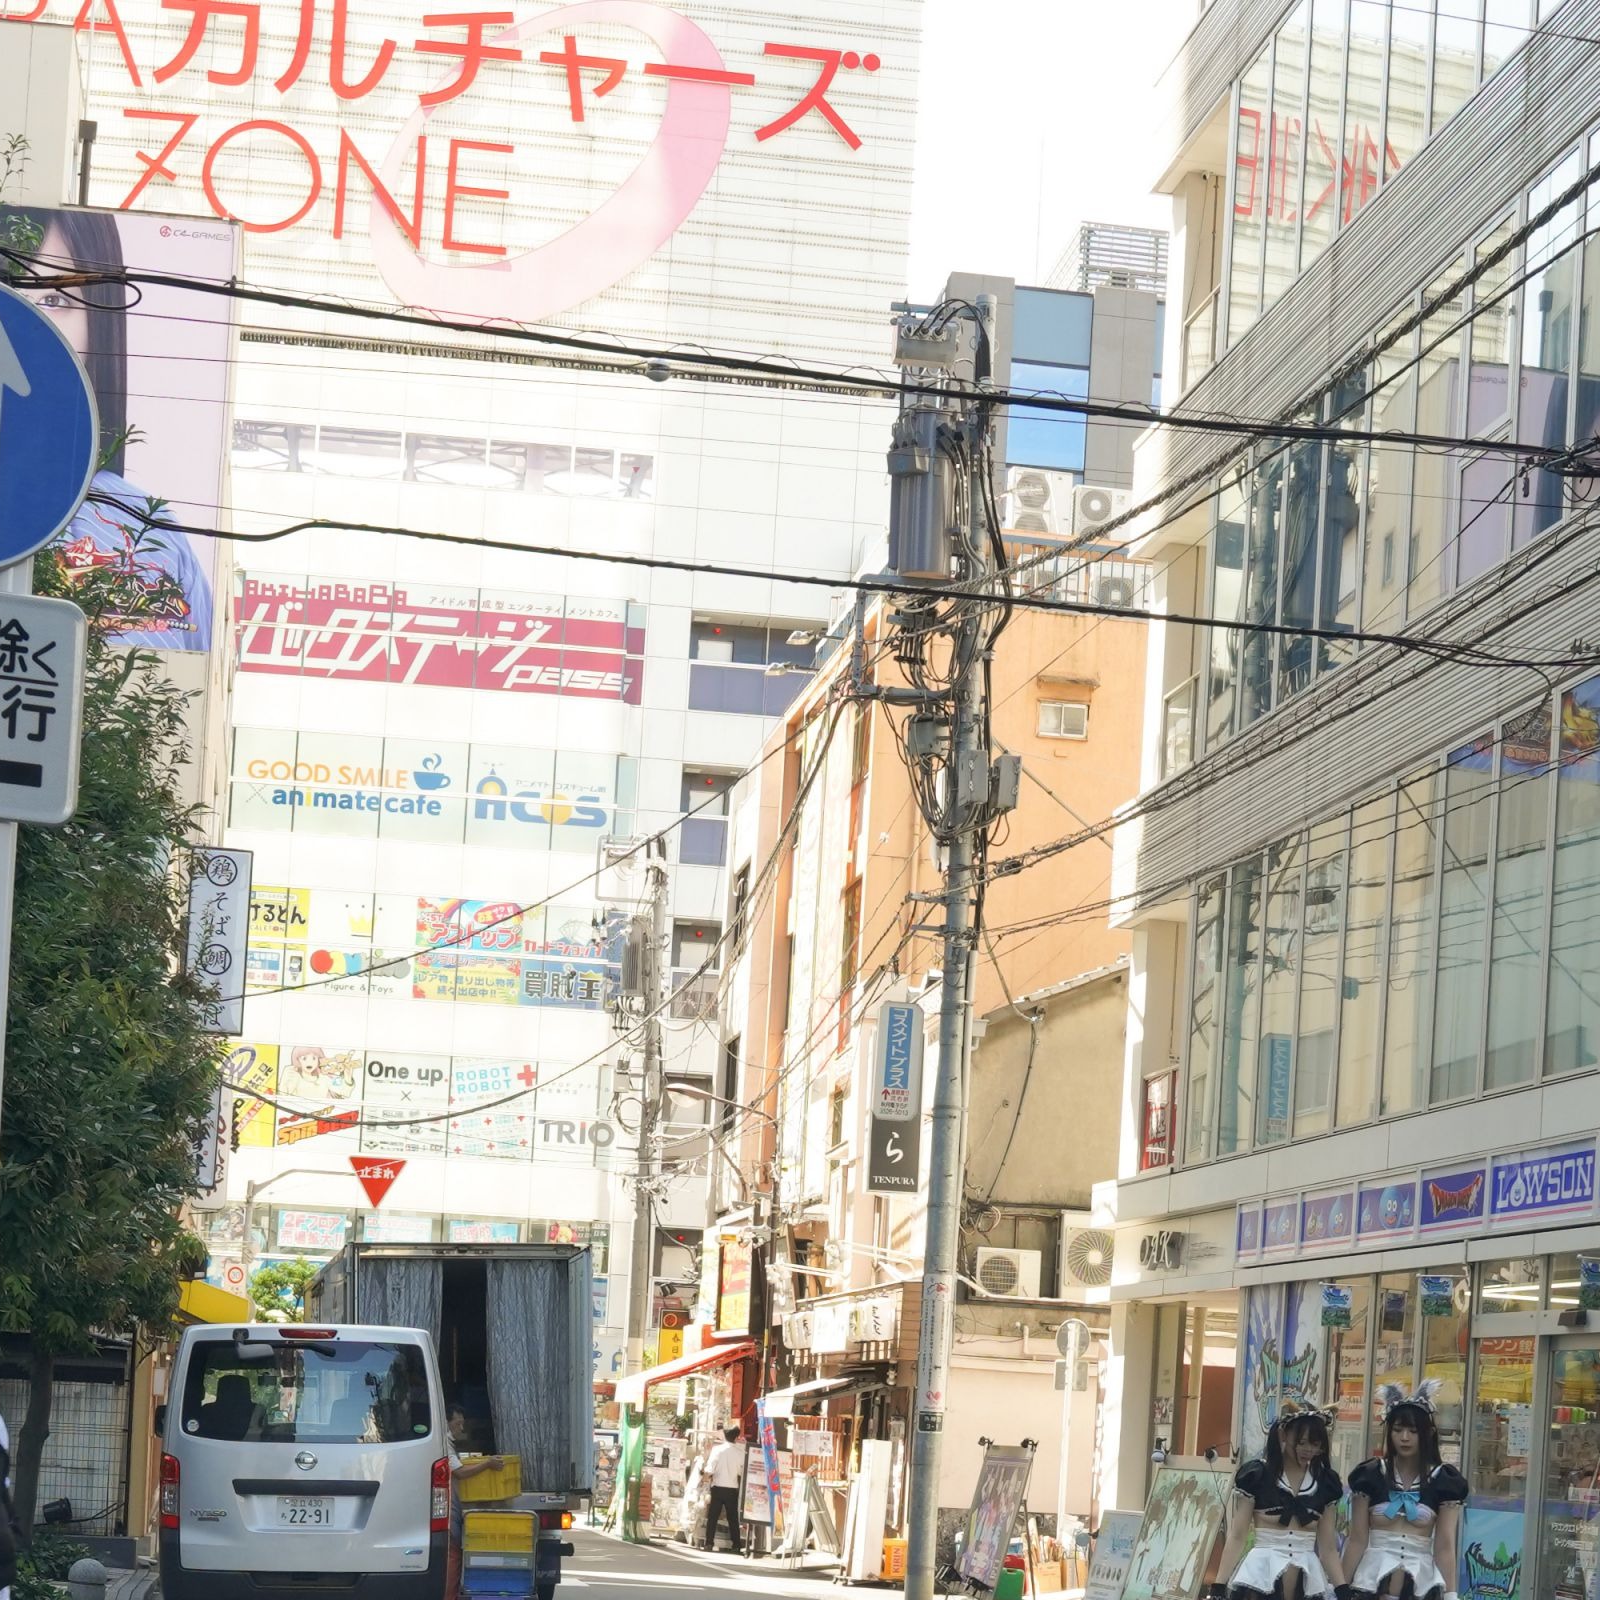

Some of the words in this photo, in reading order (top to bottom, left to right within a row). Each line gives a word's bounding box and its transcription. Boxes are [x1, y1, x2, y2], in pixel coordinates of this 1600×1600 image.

[120, 107, 516, 257] ZONE
[502, 664, 633, 696] pass
[246, 758, 331, 785] GOOD
[337, 764, 409, 791] SMILE
[271, 785, 380, 812] animate
[384, 793, 443, 816] cafe
[324, 982, 356, 992] Figure
[367, 1060, 410, 1080] One
[455, 1066, 511, 1082] ROBOT
[456, 1079, 512, 1095] ROBOT
[538, 1119, 616, 1148] TRIO
[357, 1166, 395, 1180] 止まれ
[872, 1175, 915, 1186] TENPURA
[288, 1508, 330, 1524] 22-91
[891, 1545, 901, 1575] KIRIN
